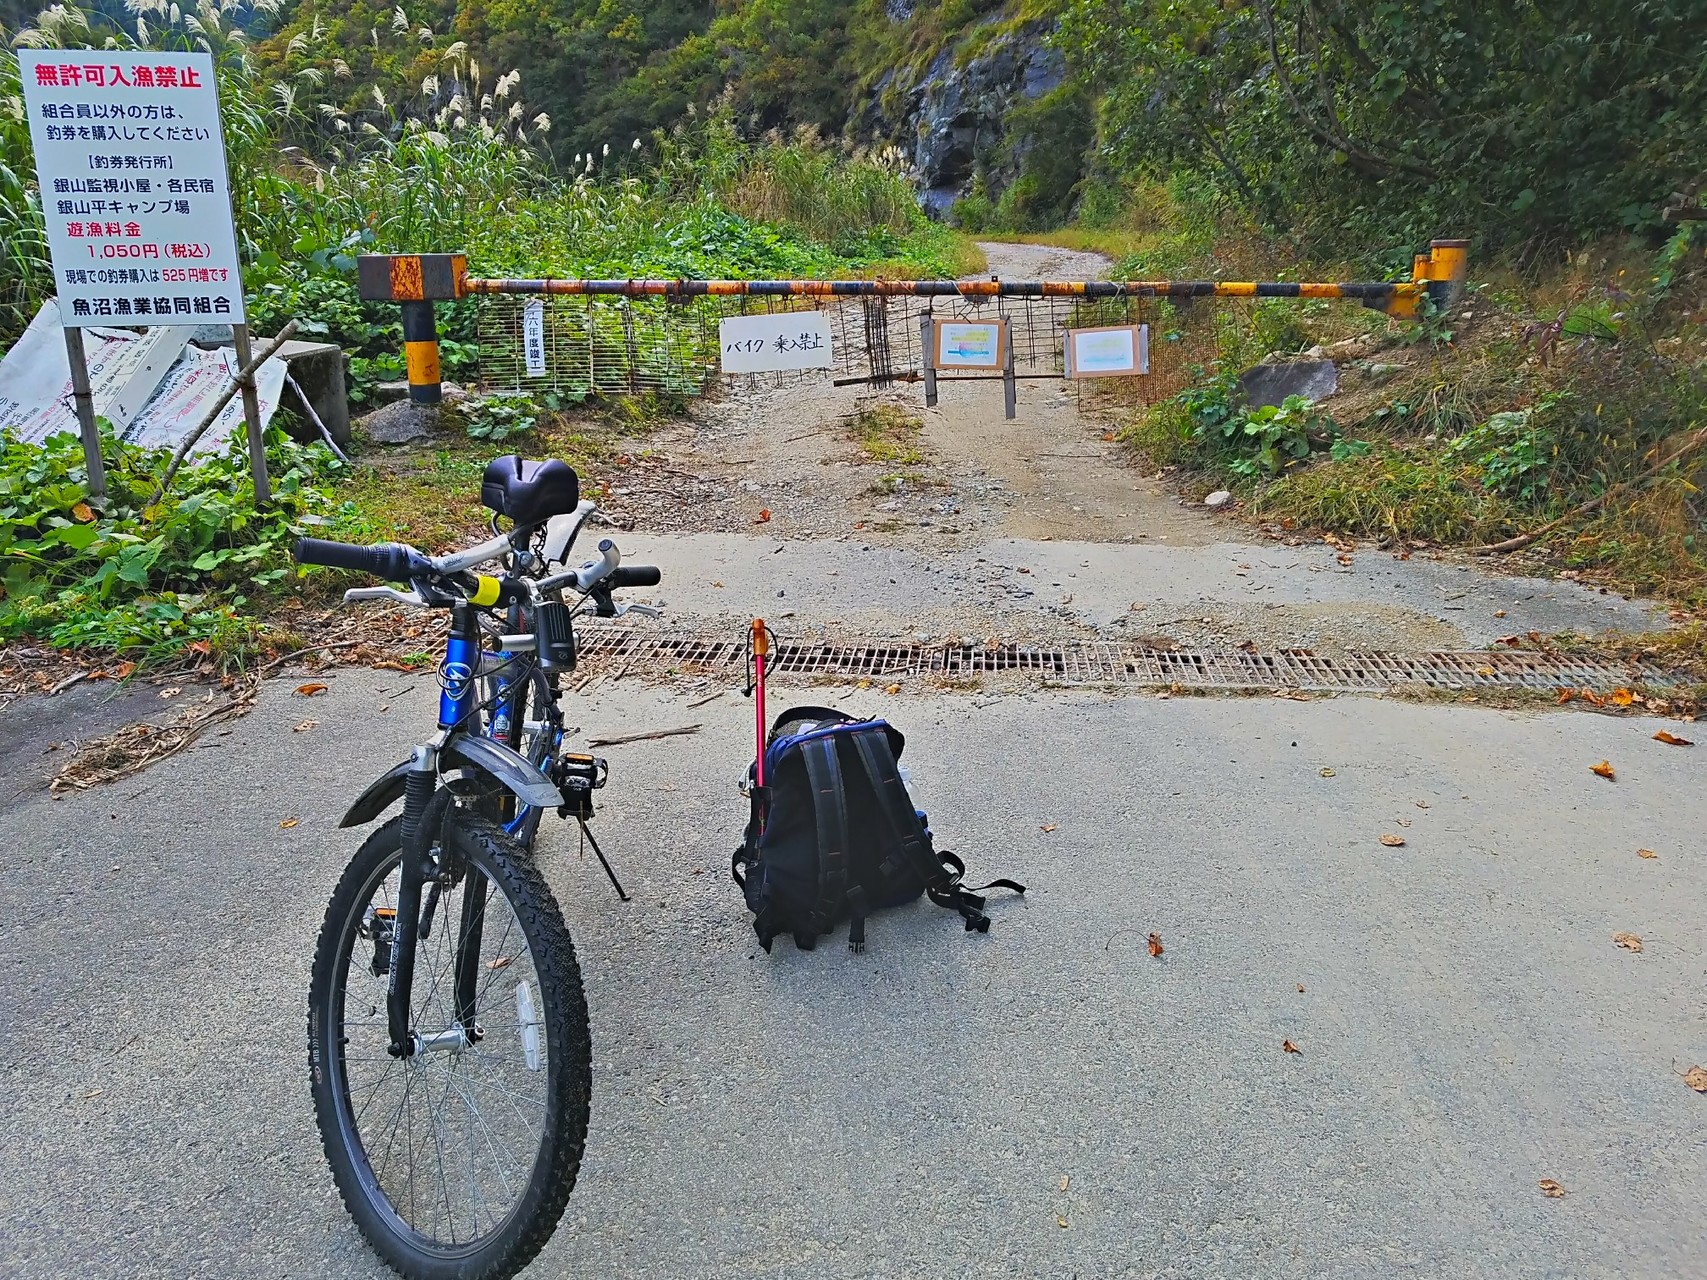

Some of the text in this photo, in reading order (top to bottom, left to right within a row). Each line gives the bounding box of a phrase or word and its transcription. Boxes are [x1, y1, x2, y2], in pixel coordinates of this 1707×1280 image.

[35, 64, 201, 87] 無許可入漁禁止
[41, 104, 183, 119] 組合員以外の方は、
[46, 125, 209, 140] 釣券を購入してください
[54, 178, 214, 193] 銀山監視小屋・各民宿
[57, 199, 189, 214] 銀山平キャンプ場
[67, 222, 141, 237] 遊漁料金
[72, 296, 230, 316] 魚沼漁業協同組合
[727, 333, 823, 353] バイク 乗入禁止
